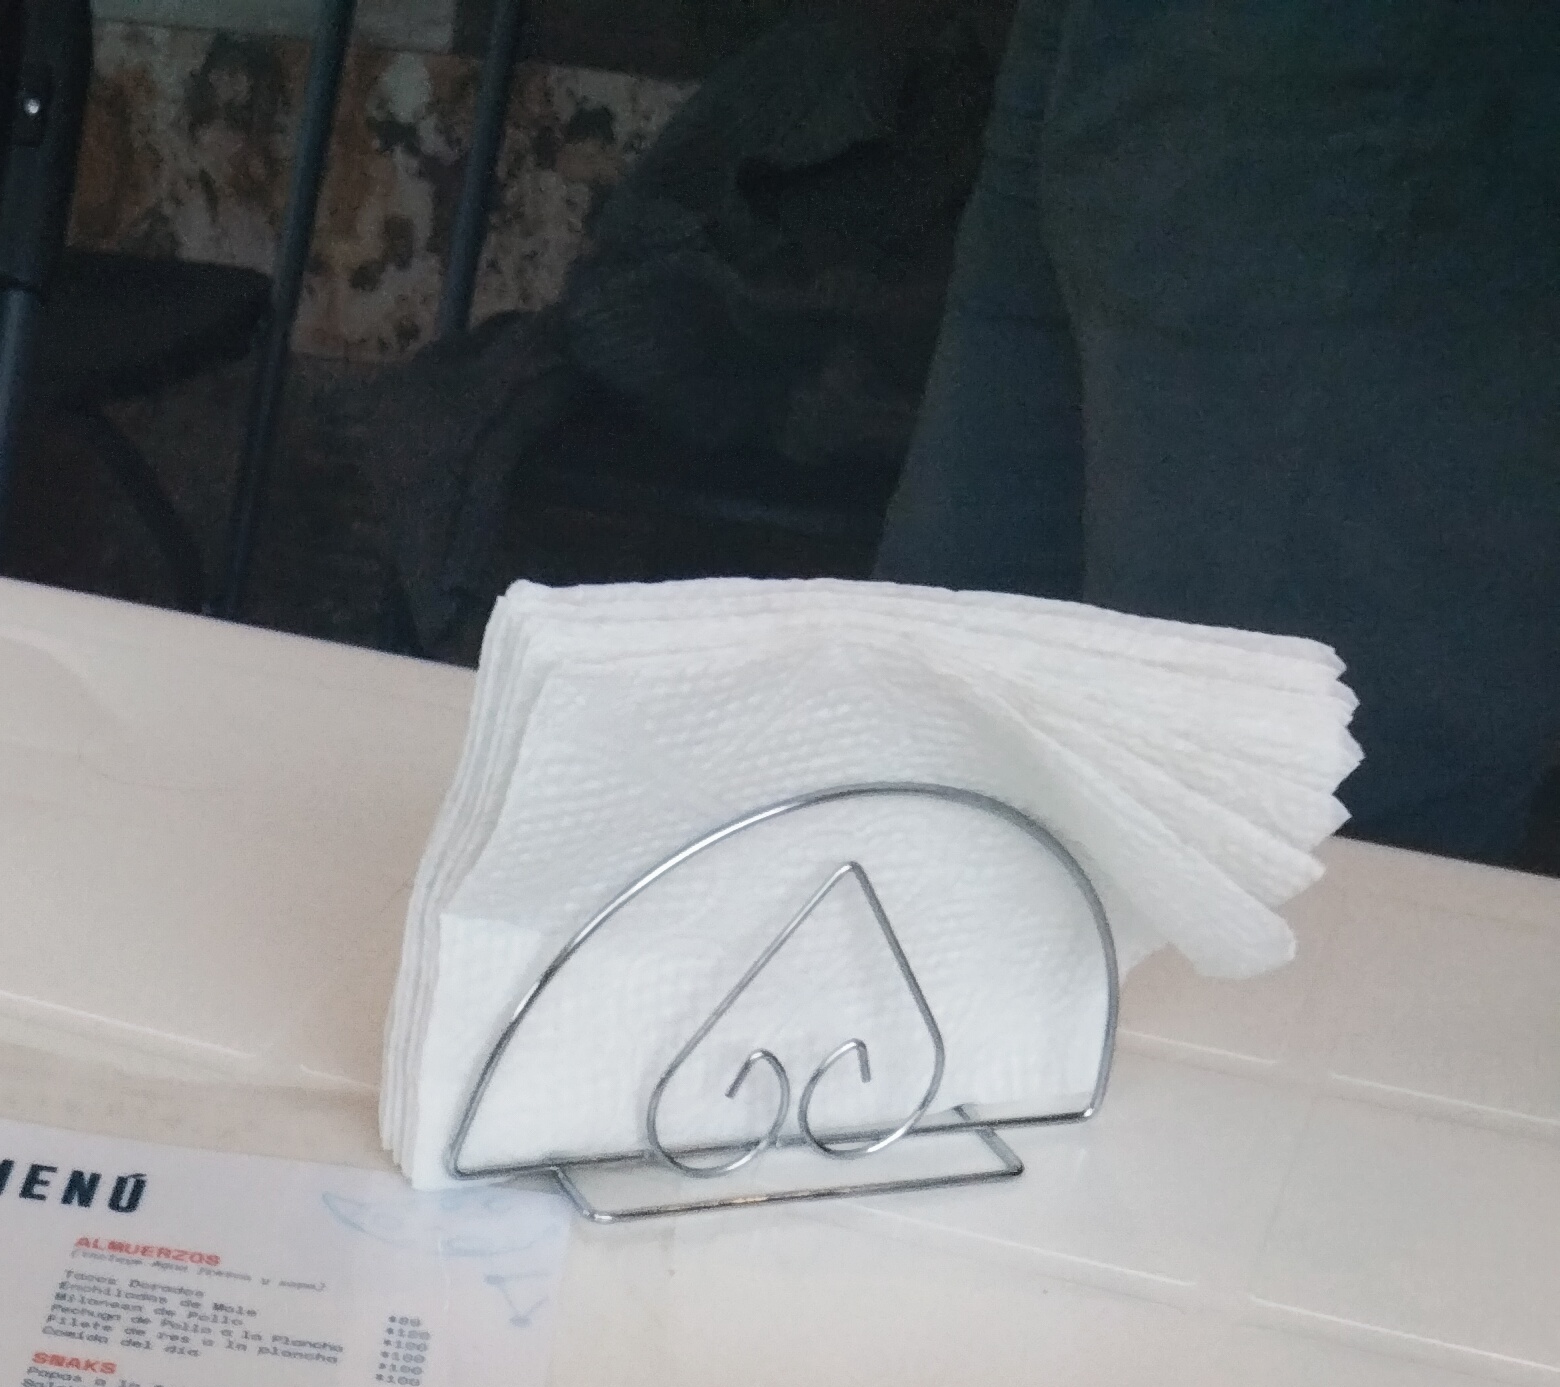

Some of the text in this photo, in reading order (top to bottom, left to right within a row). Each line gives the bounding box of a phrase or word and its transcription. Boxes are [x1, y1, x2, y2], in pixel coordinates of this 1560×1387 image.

[74, 1237, 220, 1266] ALMUERZOS
[26, 1366, 82, 1382] Papas
[32, 1351, 116, 1374] SNAKS
